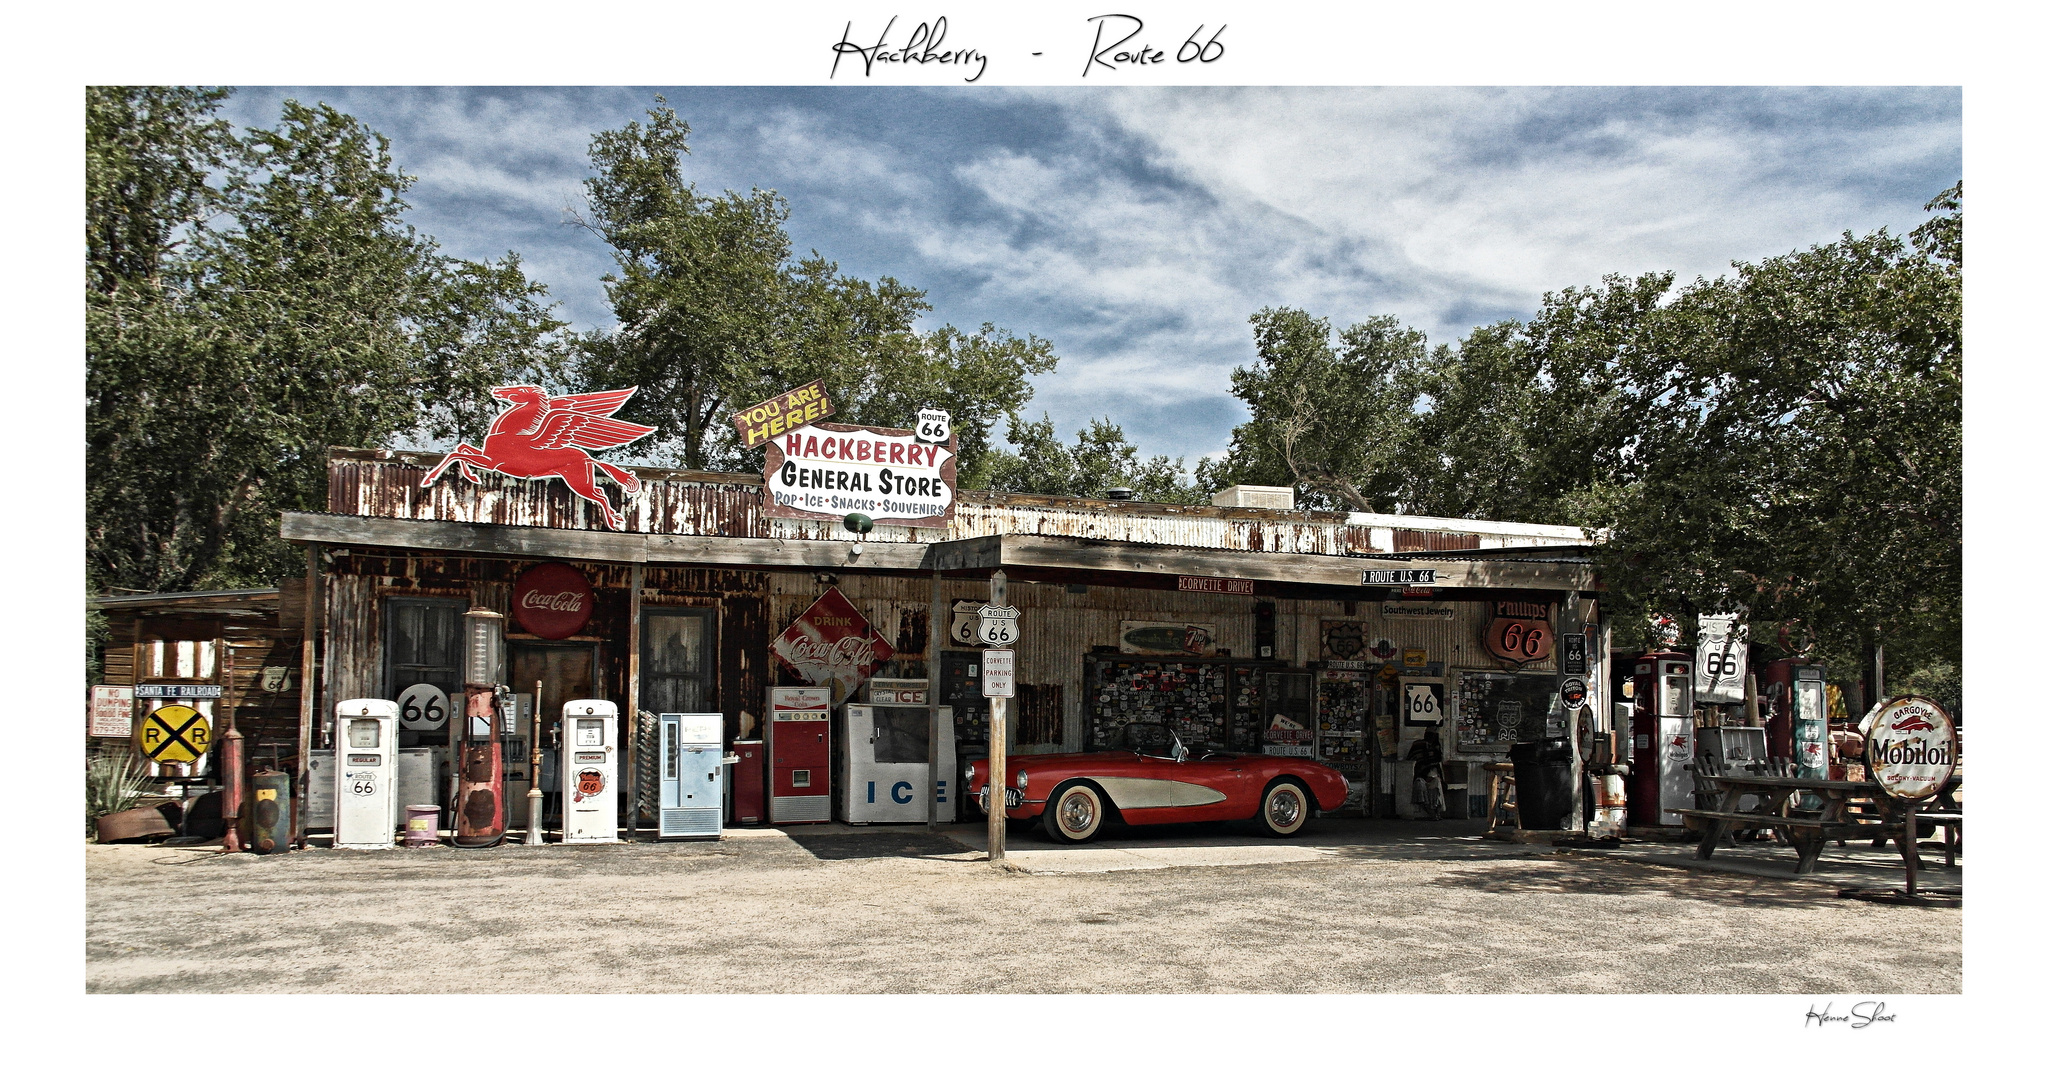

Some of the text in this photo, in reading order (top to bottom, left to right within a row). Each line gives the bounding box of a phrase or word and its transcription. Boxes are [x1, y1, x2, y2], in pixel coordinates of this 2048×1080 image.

[740, 384, 822, 426] YOU ARE
[747, 398, 827, 445] HERE!
[921, 413, 947, 422] ROUTE
[920, 422, 945, 438] 66
[786, 433, 939, 467] HACKBERRY
[781, 460, 942, 497] GENERAL STORE
[775, 490, 945, 517] POP ICE SNACKS SOUVENIRS
[1369, 570, 1430, 583] ROUTE U.S. 66
[1182, 577, 1250, 593] CORVETTE DRIVE
[1383, 605, 1453, 618] Southwest Jewelry
[1497, 601, 1547, 620] Phillips
[813, 616, 852, 627] DRINK
[960, 622, 981, 639] 6
[988, 627, 1009, 641] 66
[1337, 641, 1354, 653] 66
[1501, 623, 1544, 658] 66
[1568, 650, 1582, 661] 66
[1328, 661, 1345, 669] ROUTE
[1707, 652, 1736, 676] 66
[108, 689, 120, 698] NO
[139, 686, 217, 696] SANTA FE RAILROAD
[895, 690, 923, 703] ICE
[96, 698, 132, 707] DUMPING
[402, 694, 444, 722] 66
[1413, 694, 1434, 713] 66
[1893, 705, 1933, 720] GARGOYLE
[146, 727, 207, 743] R R
[1265, 730, 1311, 740] CORVETTE DRIVE
[1269, 746, 1286, 755] ROUTE
[1300, 747, 1308, 755] 66
[1872, 738, 1953, 766] Mobiloil
[354, 781, 374, 793] 66
[583, 781, 597, 791] 66
